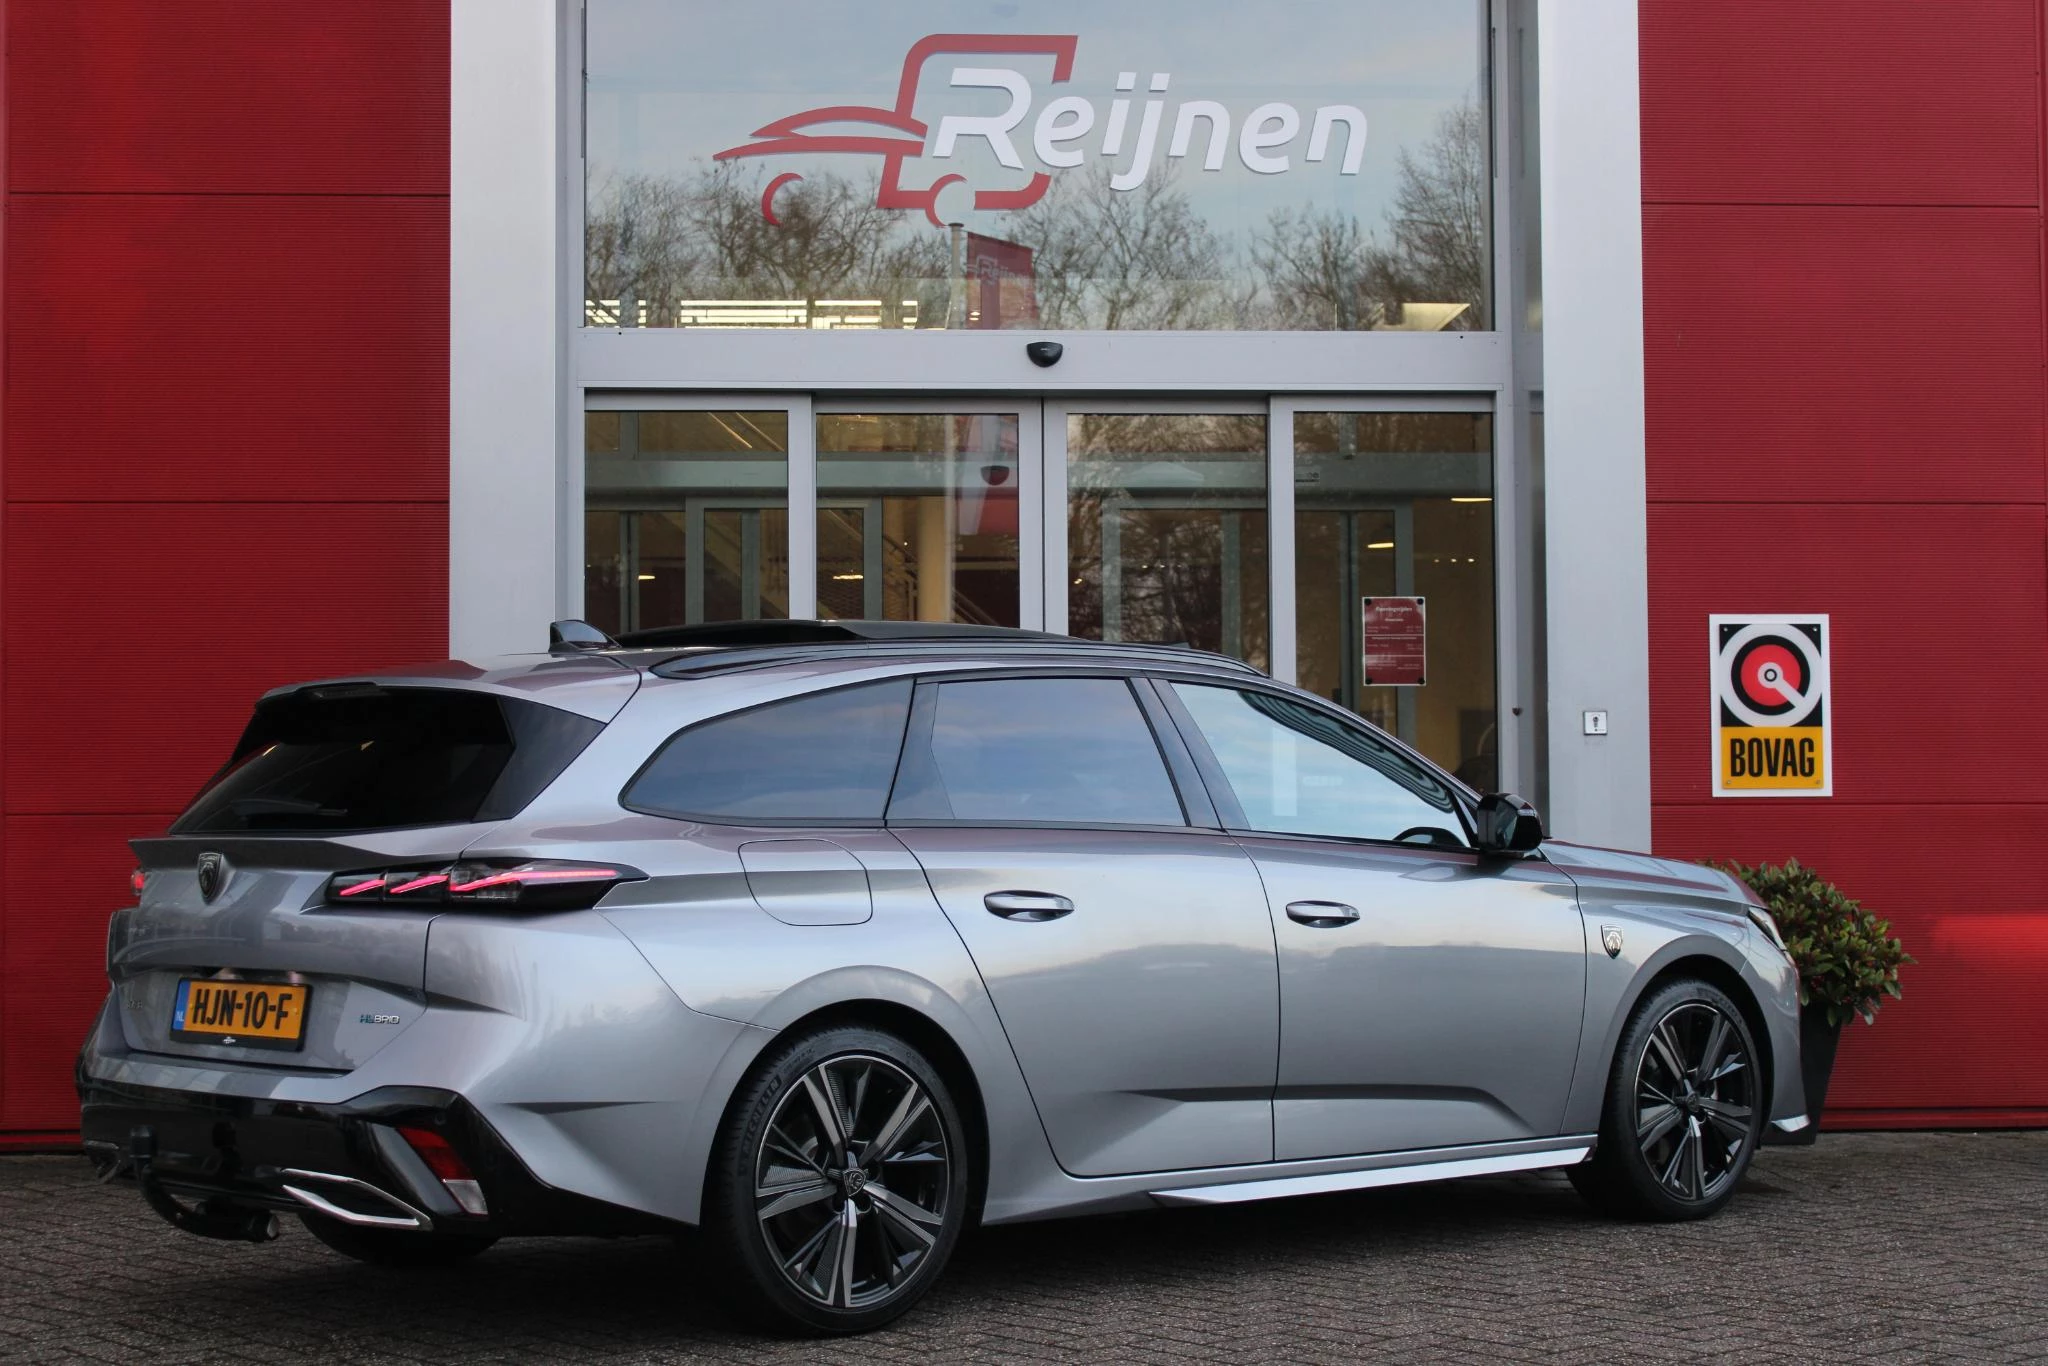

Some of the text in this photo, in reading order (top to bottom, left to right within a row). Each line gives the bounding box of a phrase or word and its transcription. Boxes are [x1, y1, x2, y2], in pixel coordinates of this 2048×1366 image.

[932, 67, 1368, 191] Reijnen
[1730, 737, 1815, 778] BOVAG
[176, 1010, 185, 1022] NL
[192, 987, 293, 1031] HJN-10-F
